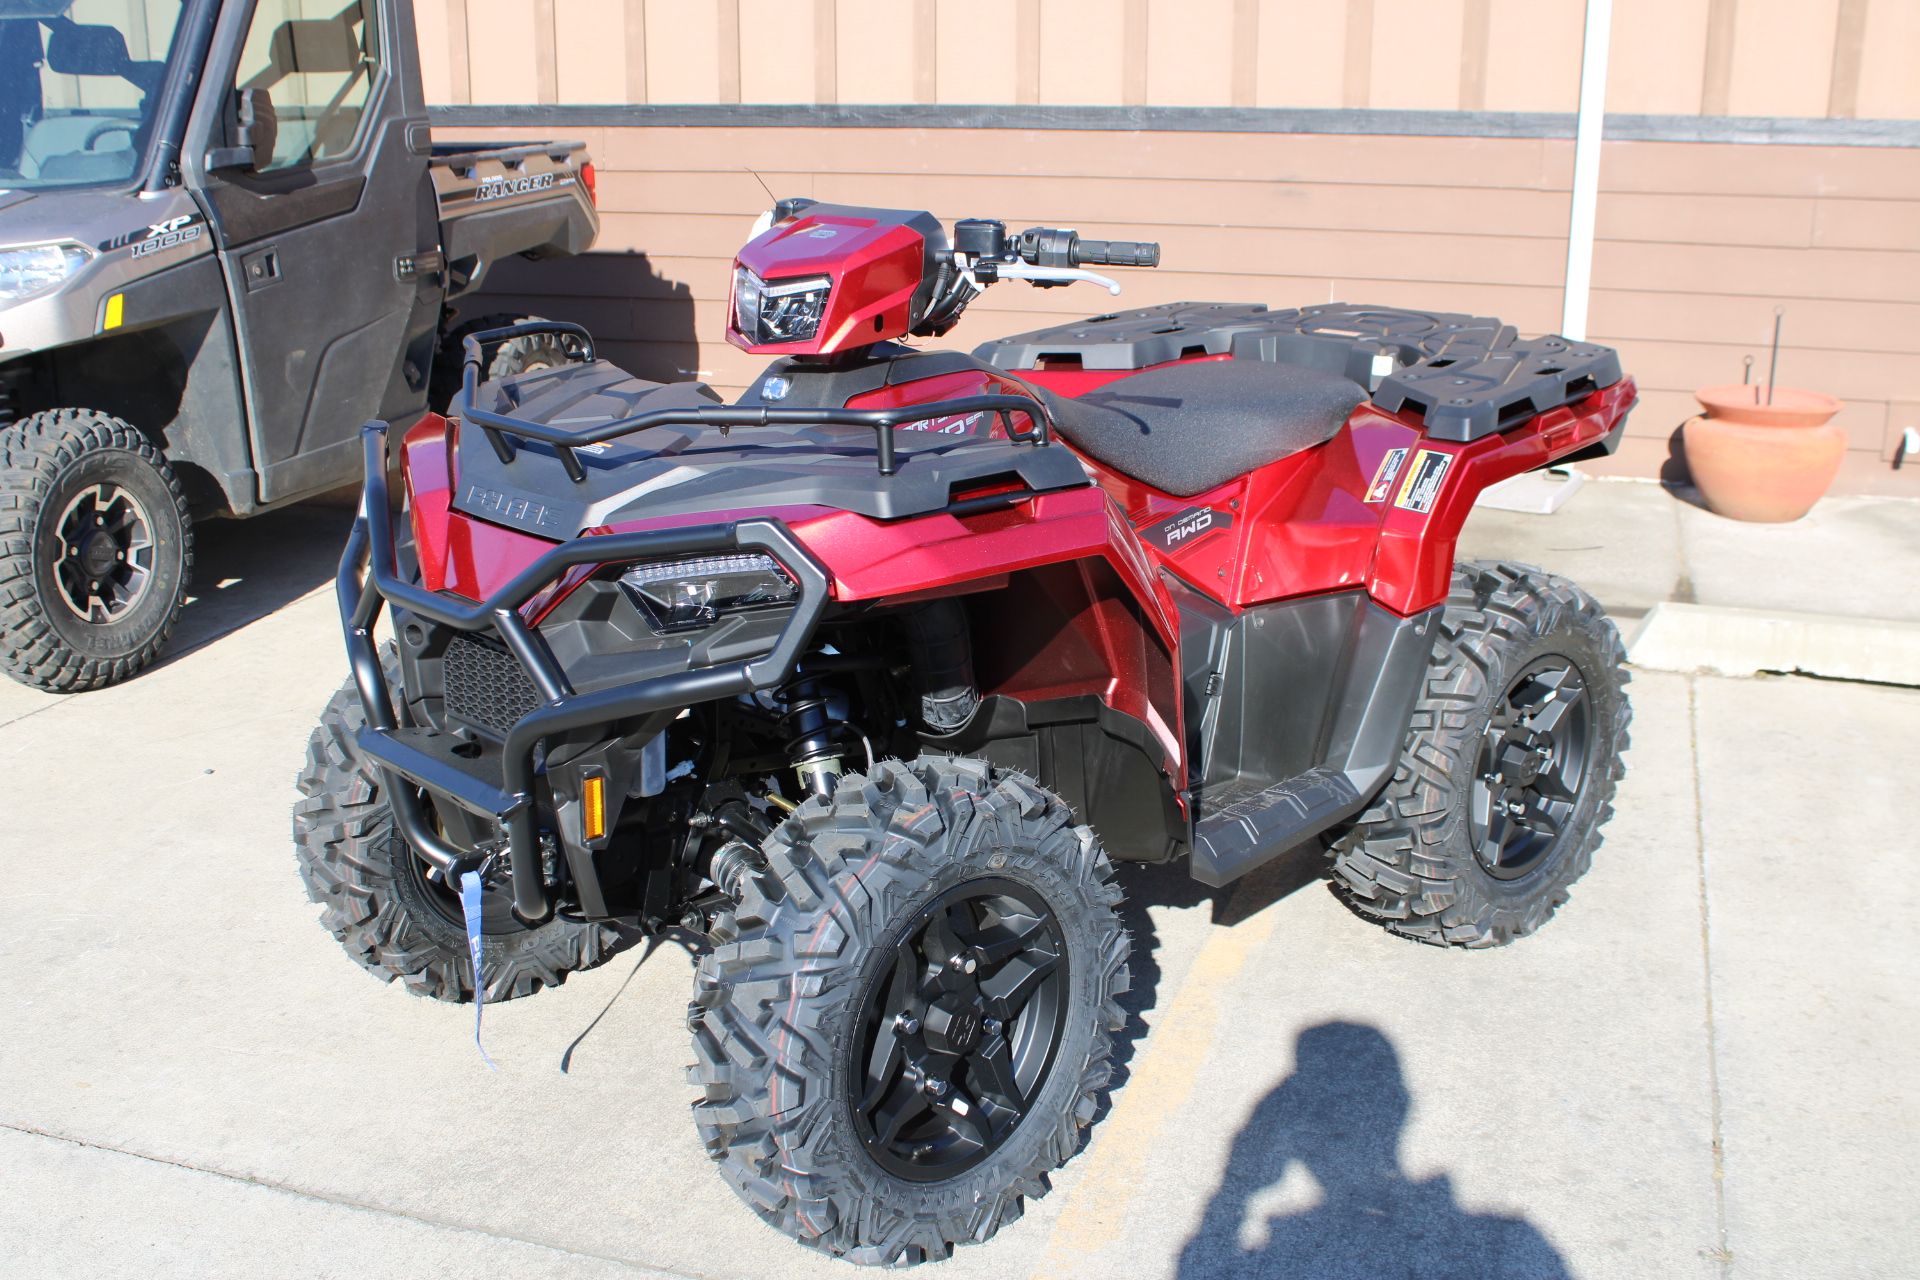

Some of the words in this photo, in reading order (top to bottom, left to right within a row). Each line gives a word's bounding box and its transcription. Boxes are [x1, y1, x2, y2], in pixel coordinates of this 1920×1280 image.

[475, 173, 553, 201] RANGER
[146, 214, 192, 238] XP
[131, 225, 201, 260] 1000
[965, 410, 985, 426] EFI
[1164, 523, 1176, 533] ON
[1177, 506, 1212, 526] DEMAND
[1166, 513, 1213, 546] AWD
